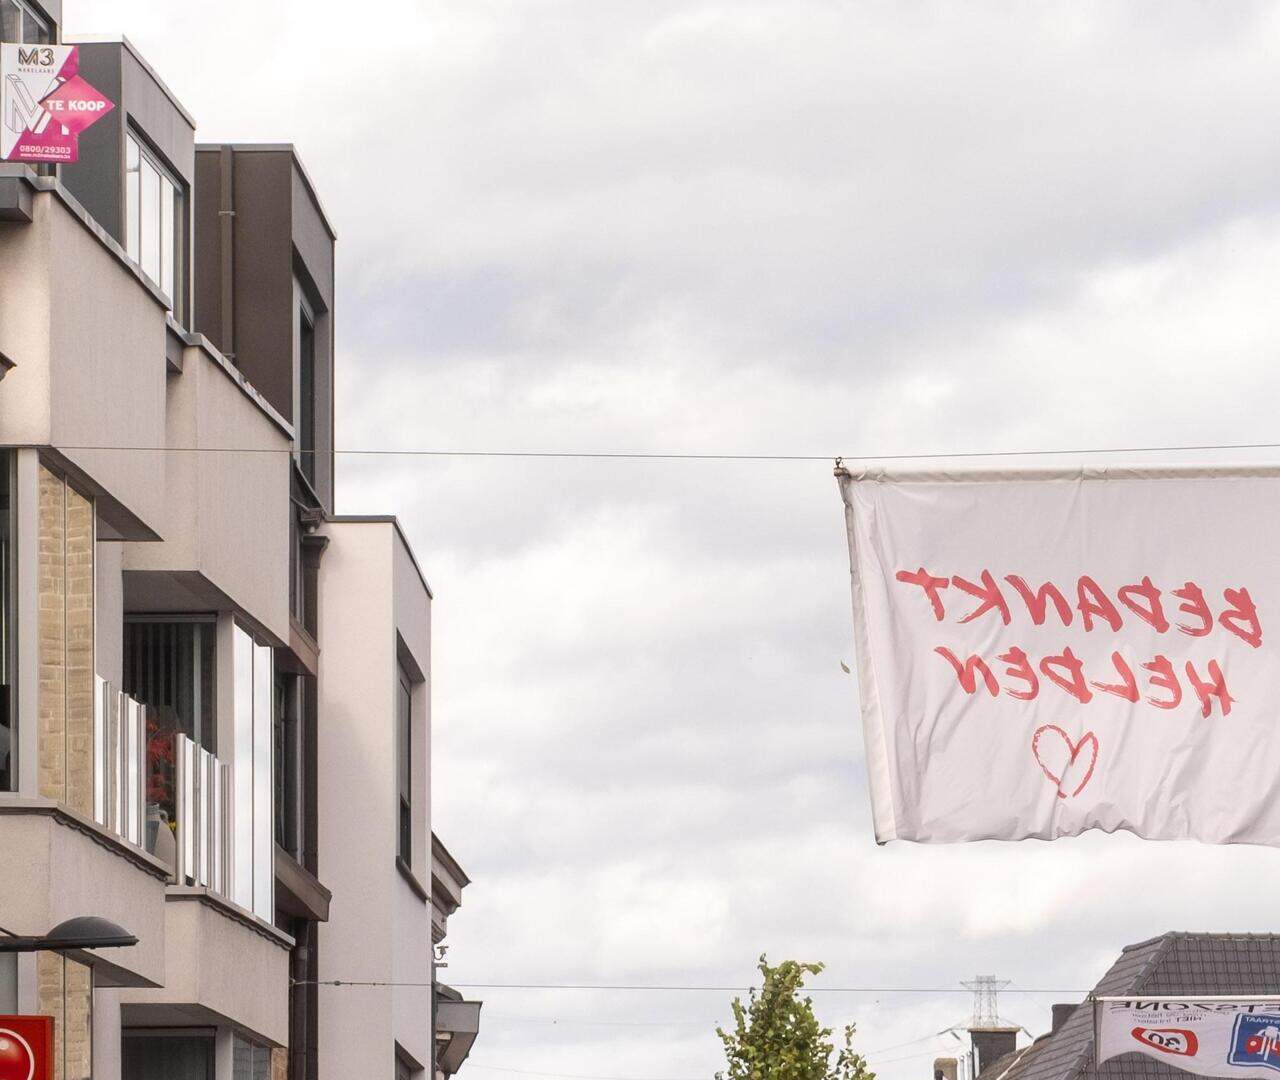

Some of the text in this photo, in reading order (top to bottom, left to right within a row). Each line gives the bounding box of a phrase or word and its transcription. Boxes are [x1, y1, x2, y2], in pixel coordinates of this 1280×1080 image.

[18, 47, 54, 66] M3
[47, 101, 105, 111] TE KOOP
